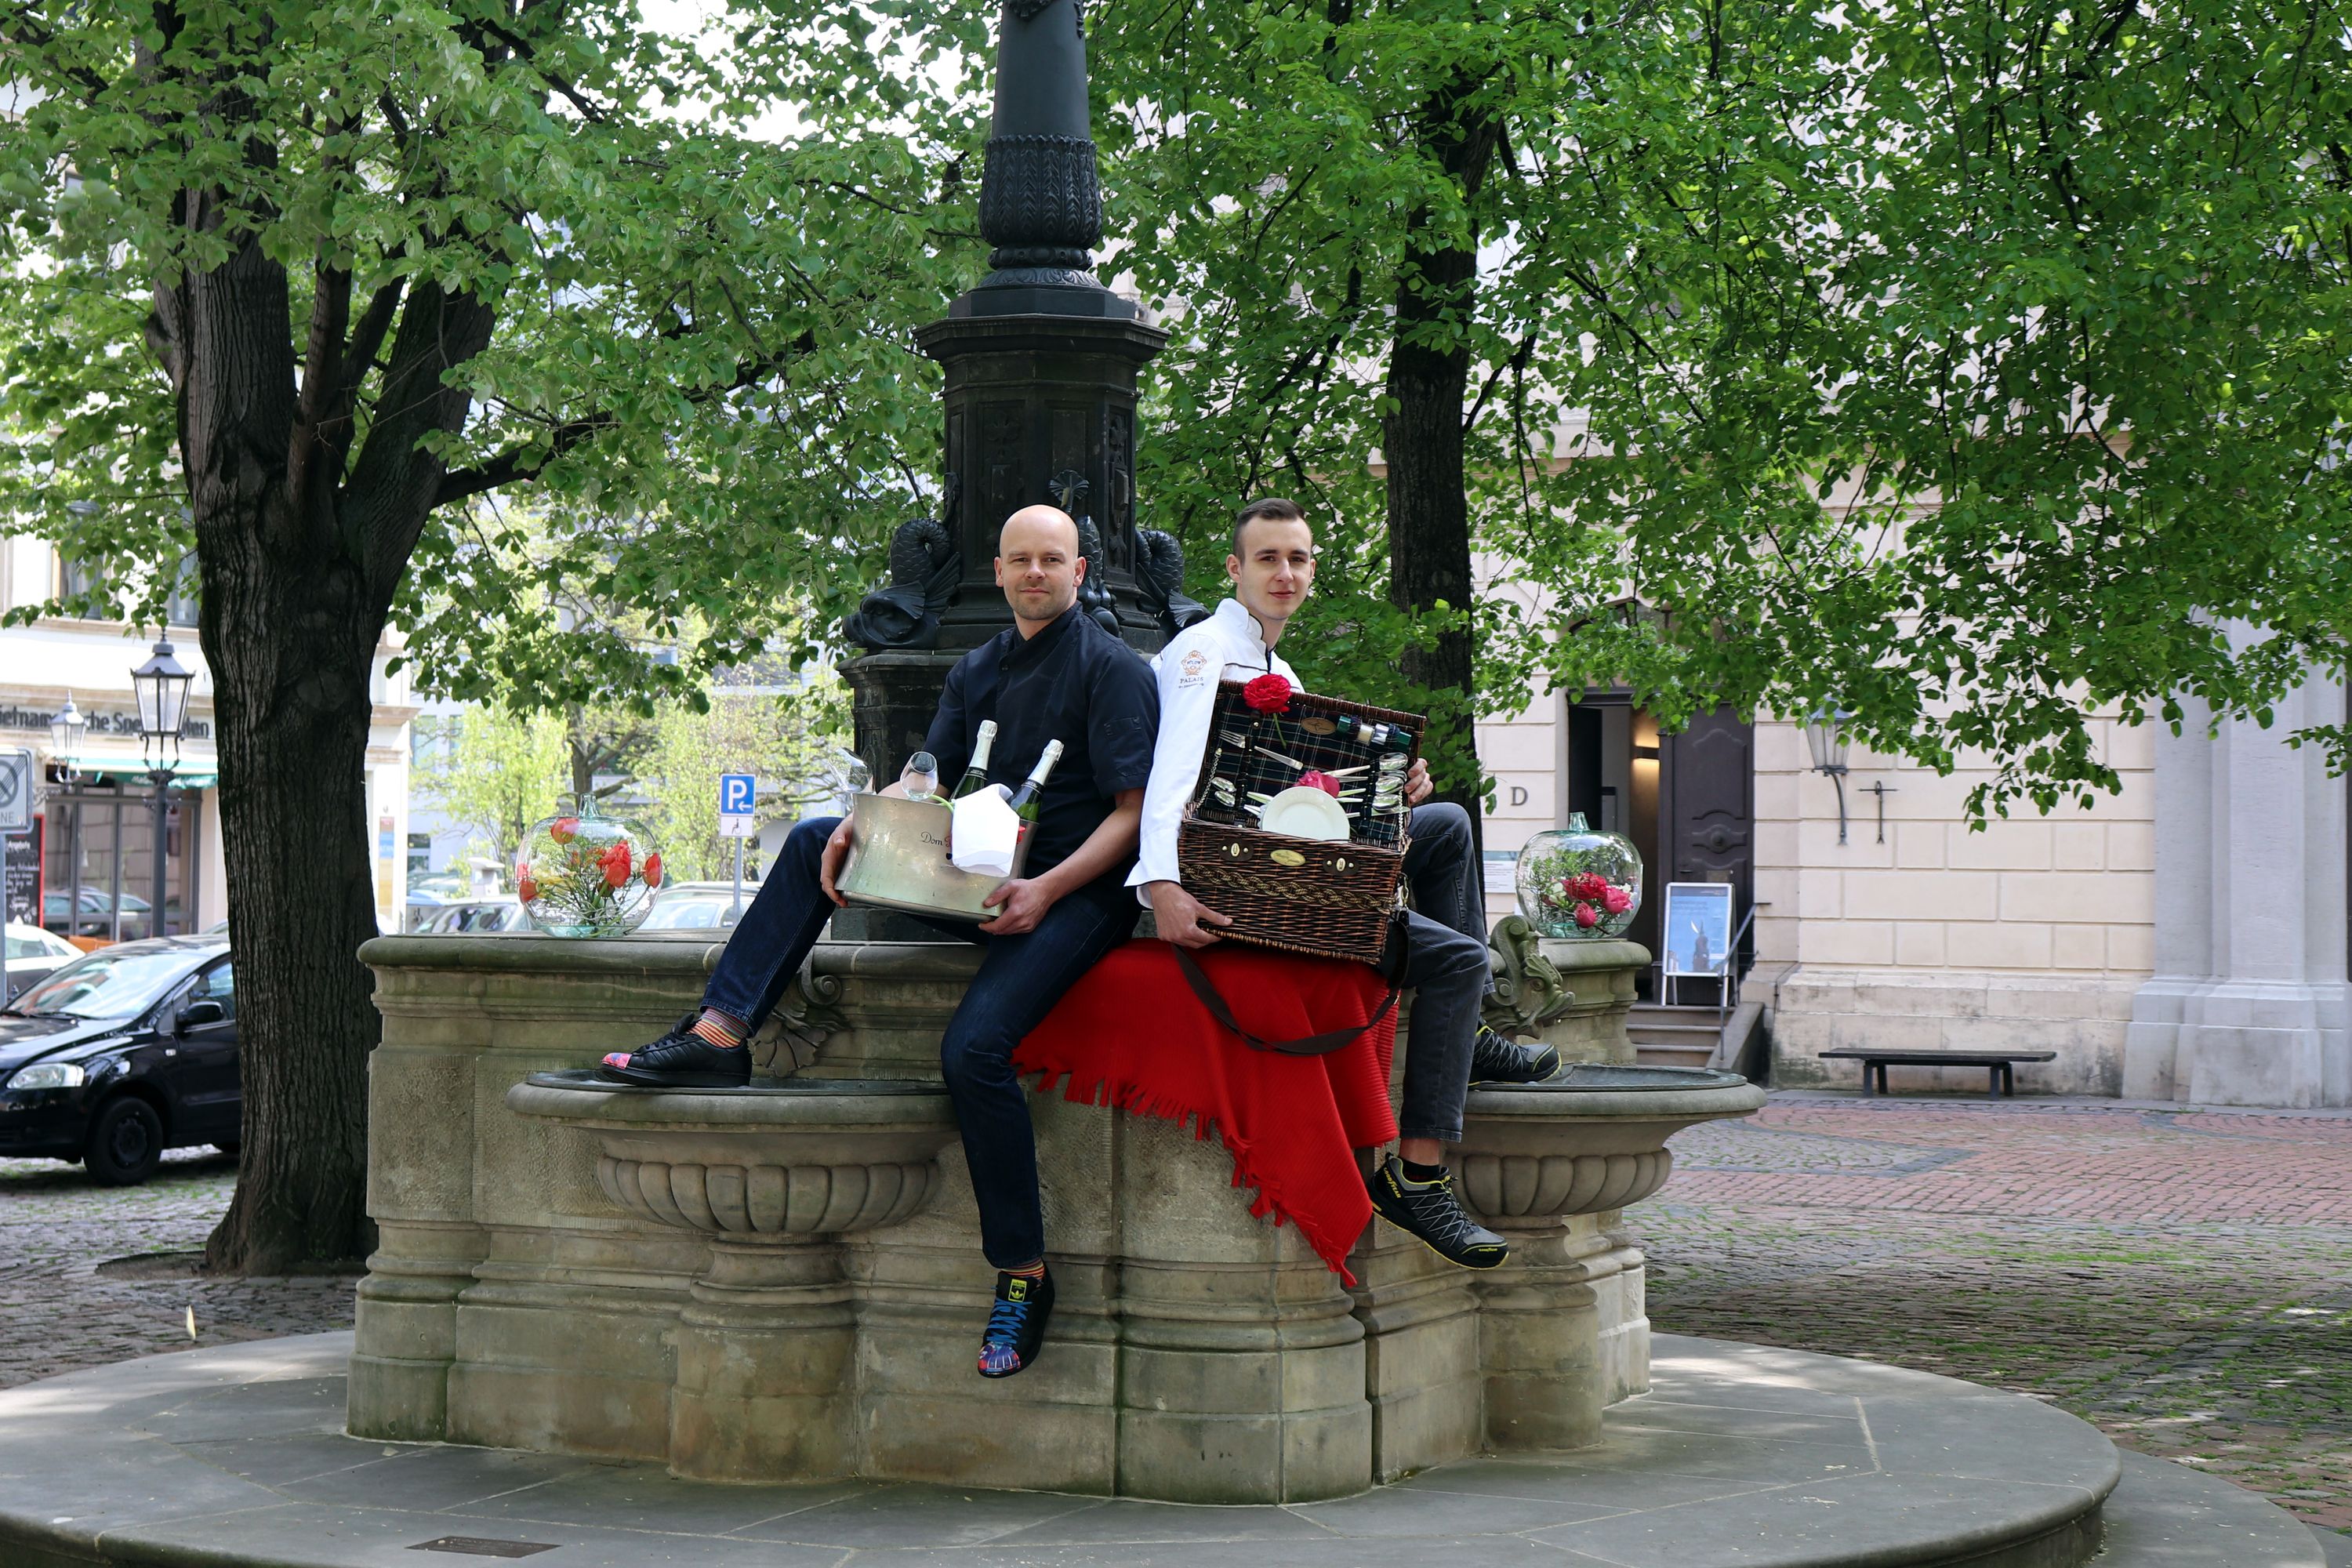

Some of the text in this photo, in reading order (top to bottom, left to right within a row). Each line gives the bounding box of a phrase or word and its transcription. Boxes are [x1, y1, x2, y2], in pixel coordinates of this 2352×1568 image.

[728, 779, 747, 810] P
[1510, 786, 1528, 806] D
[0, 811, 14, 824] NE
[920, 831, 942, 845] Dom
[1383, 1167, 1402, 1199] GOODYEAR
